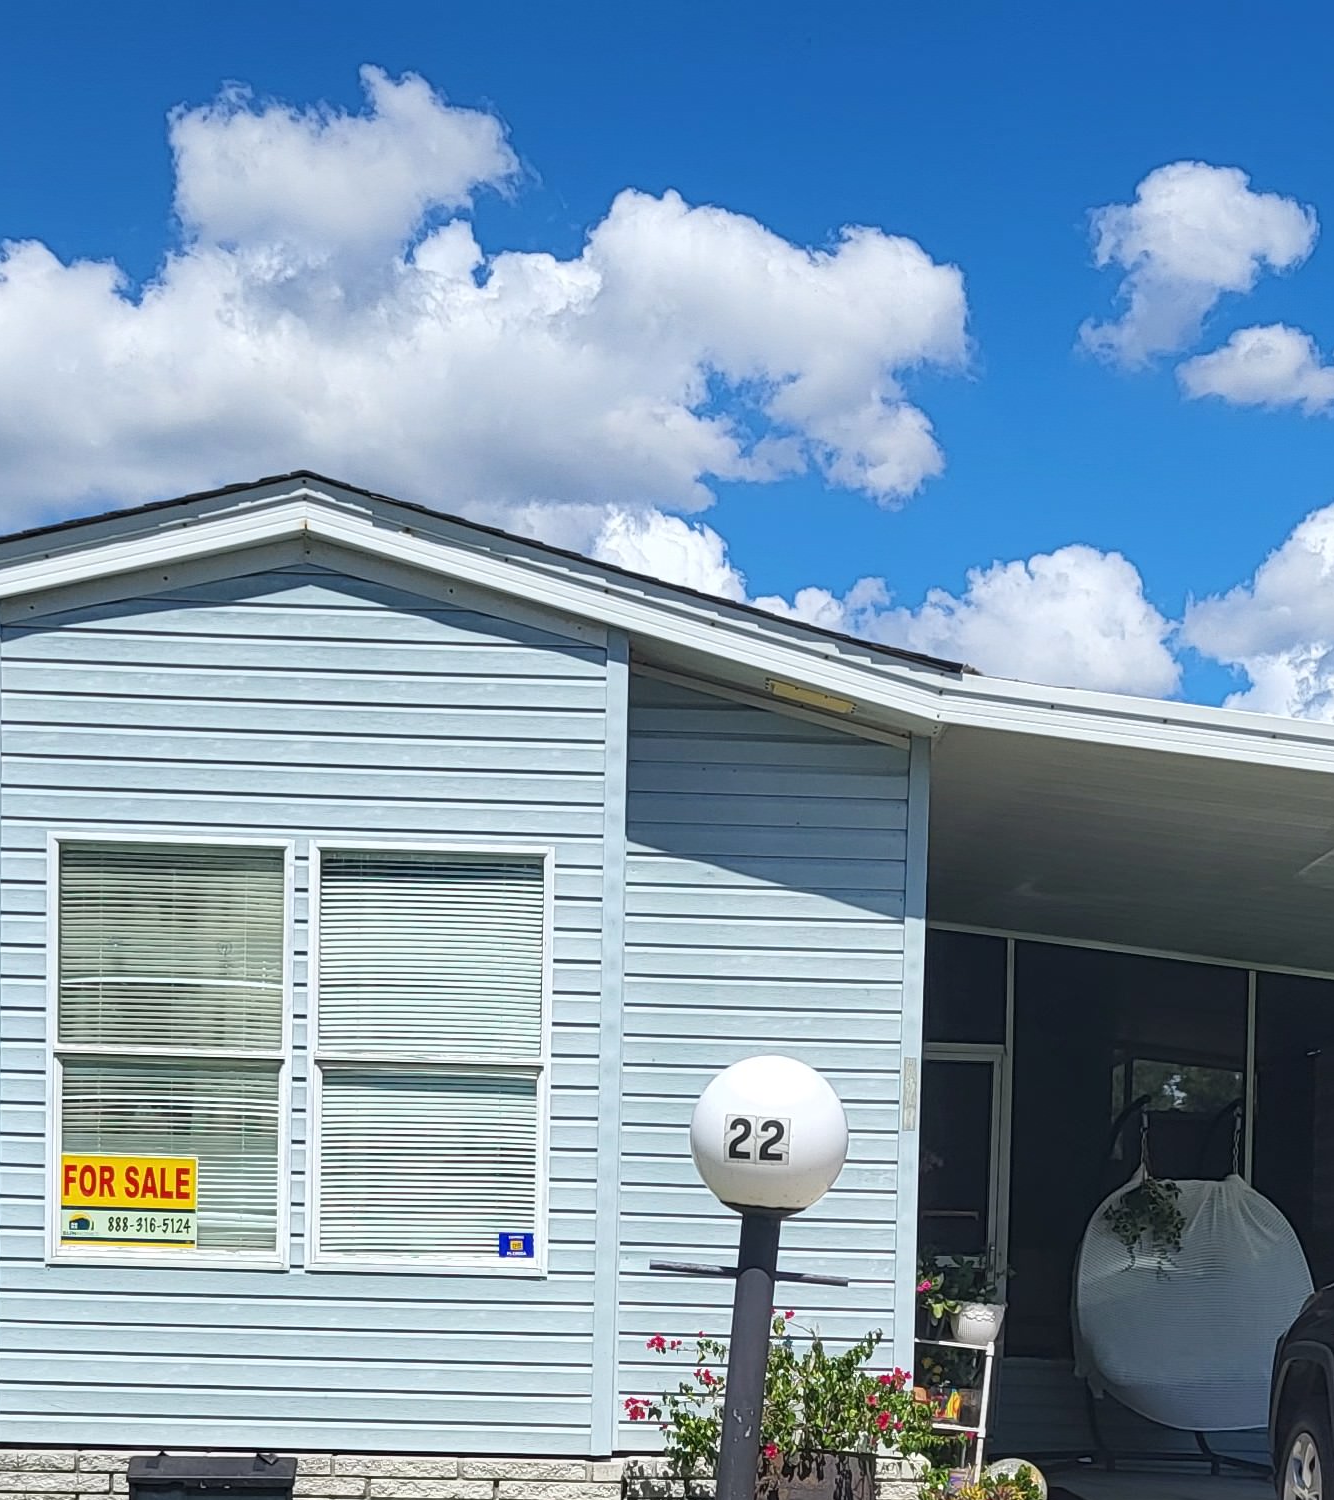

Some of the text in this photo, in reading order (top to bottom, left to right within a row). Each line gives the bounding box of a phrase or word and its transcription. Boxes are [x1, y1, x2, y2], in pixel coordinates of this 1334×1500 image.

[728, 1117, 785, 1162] 22
[63, 1164, 191, 1200] FOR SALE
[107, 1216, 192, 1235] 888-316-5124
